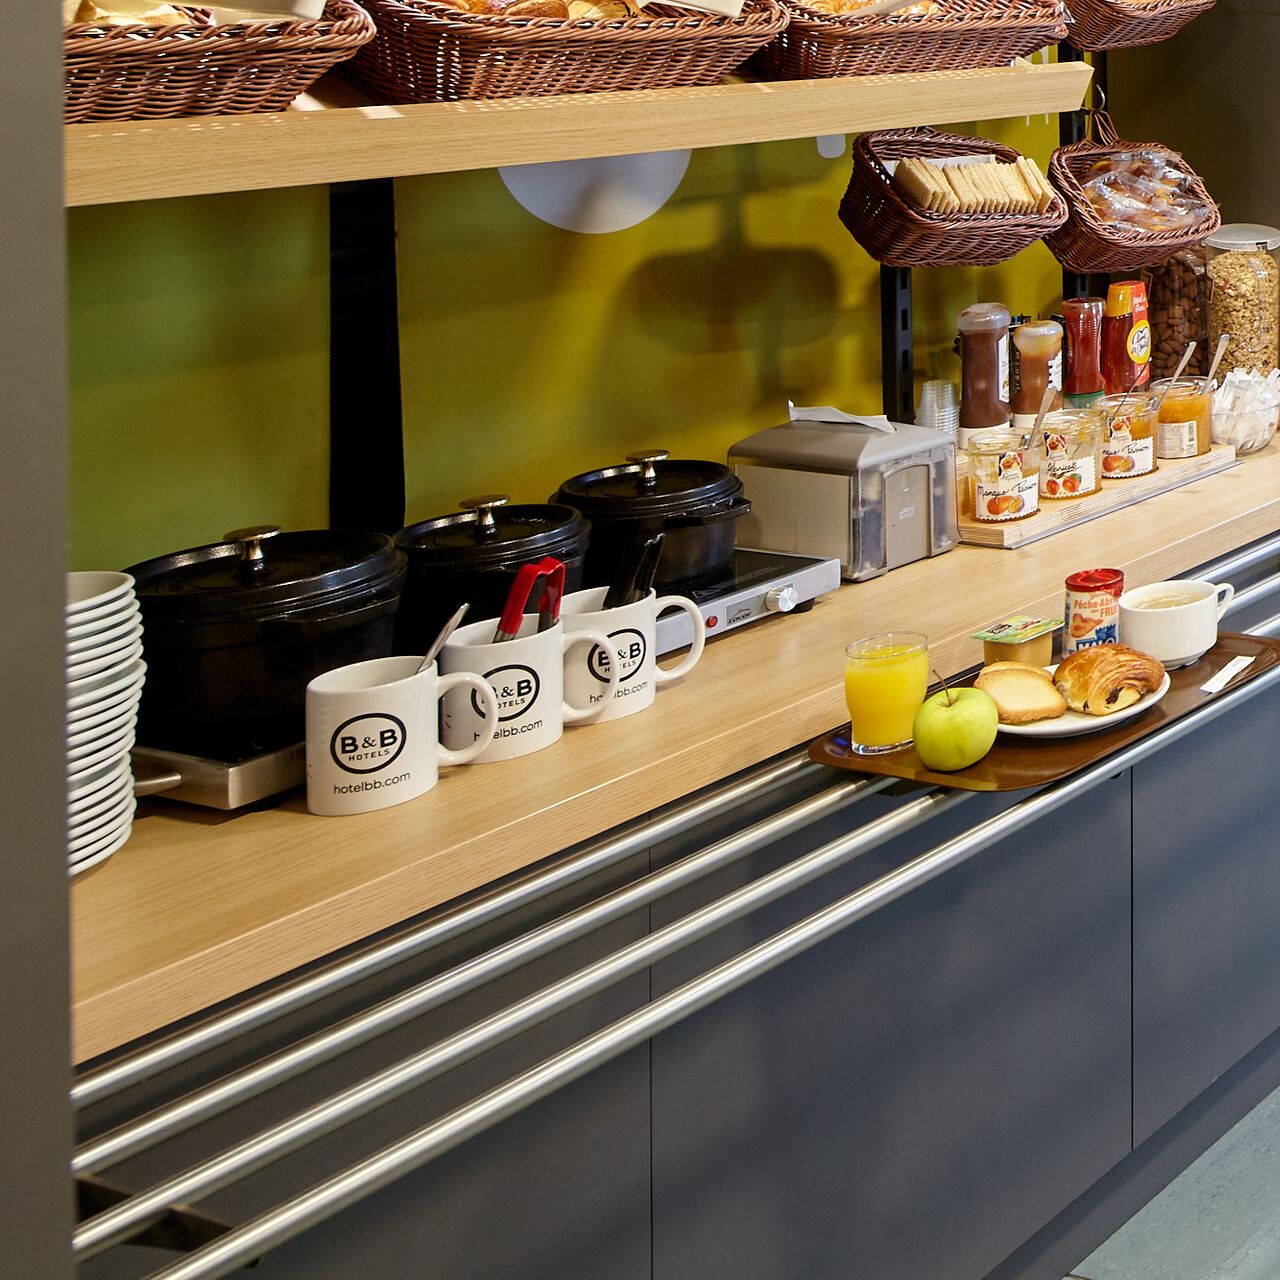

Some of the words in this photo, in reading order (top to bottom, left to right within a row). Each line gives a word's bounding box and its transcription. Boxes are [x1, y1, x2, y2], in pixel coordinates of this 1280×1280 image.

[604, 659, 637, 673] HELS
[589, 681, 649, 704] holbb.com
[473, 720, 543, 742] helbb.com
[348, 748, 390, 762] HOTELS
[333, 771, 411, 795] hotelbb.com
